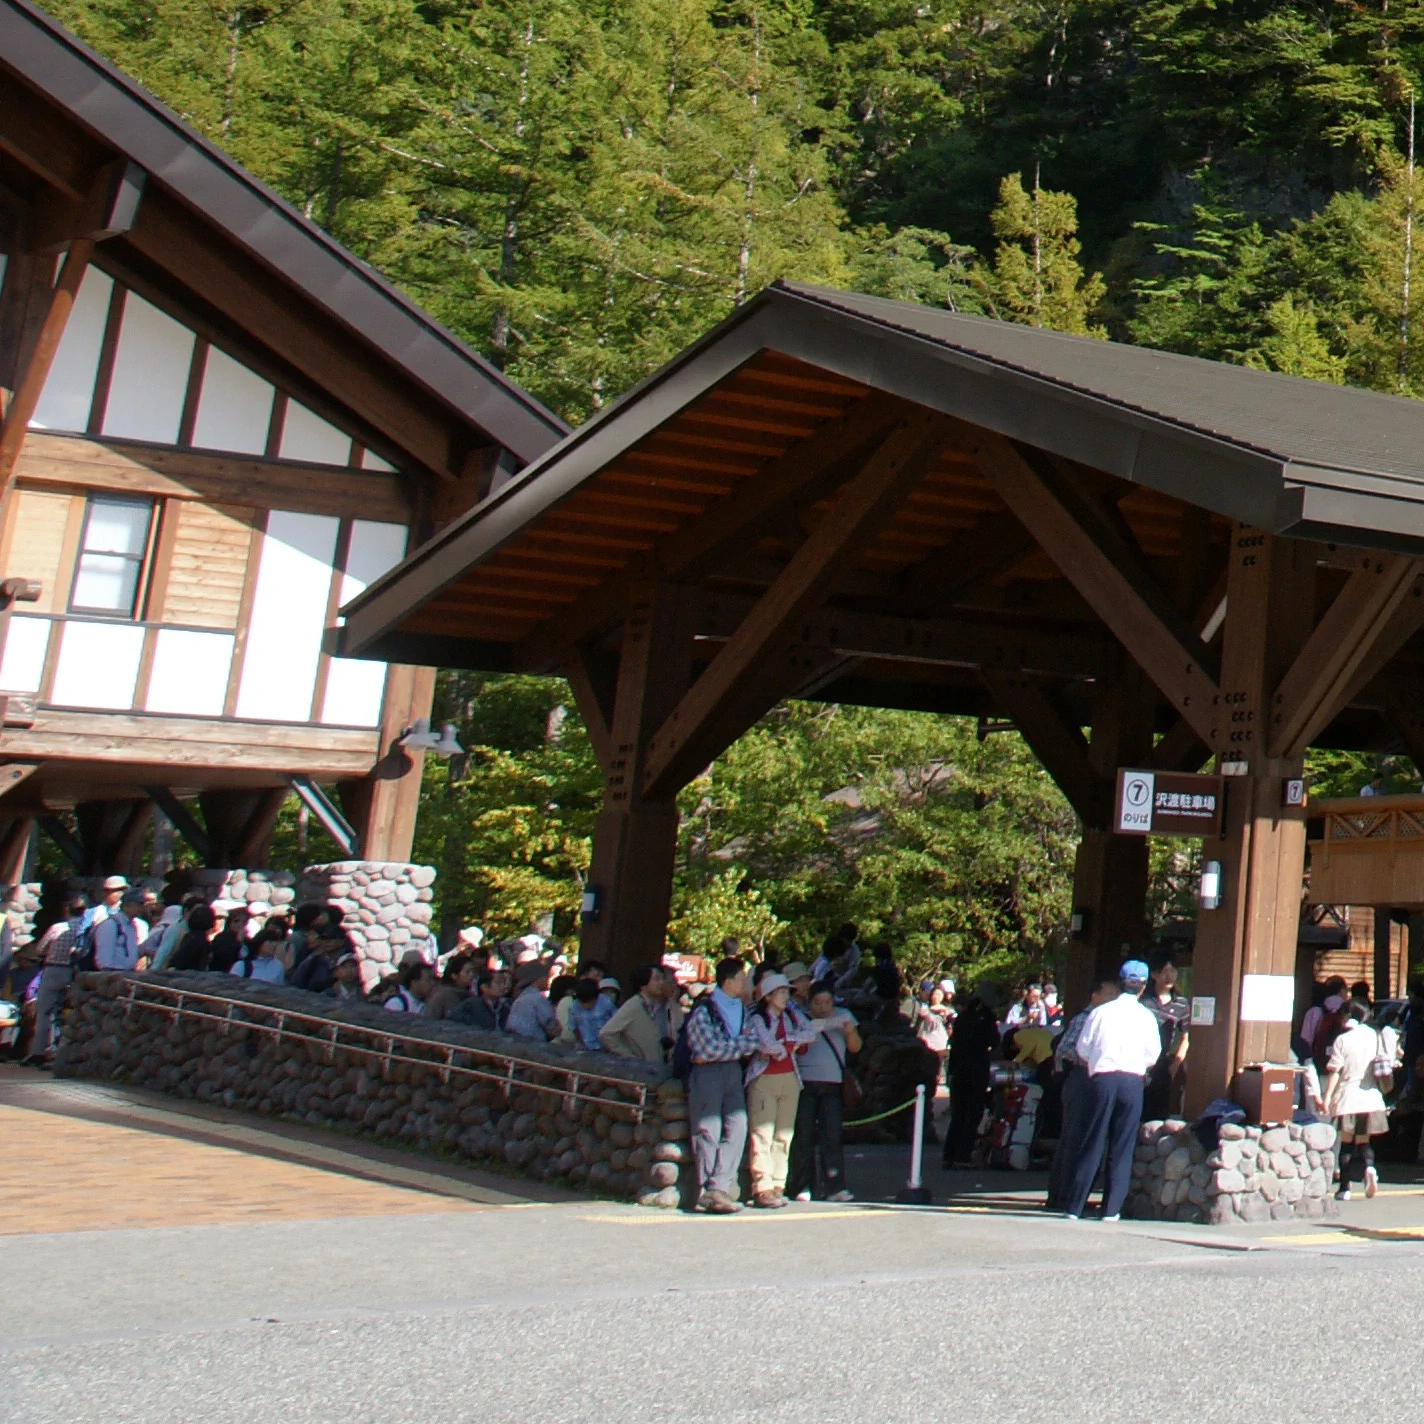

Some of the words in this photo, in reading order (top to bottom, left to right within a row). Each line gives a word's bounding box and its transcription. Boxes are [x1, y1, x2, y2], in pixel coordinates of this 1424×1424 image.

[1155, 792, 1216, 811] 沢渡駐車場
[1123, 813, 1149, 824] のりば
